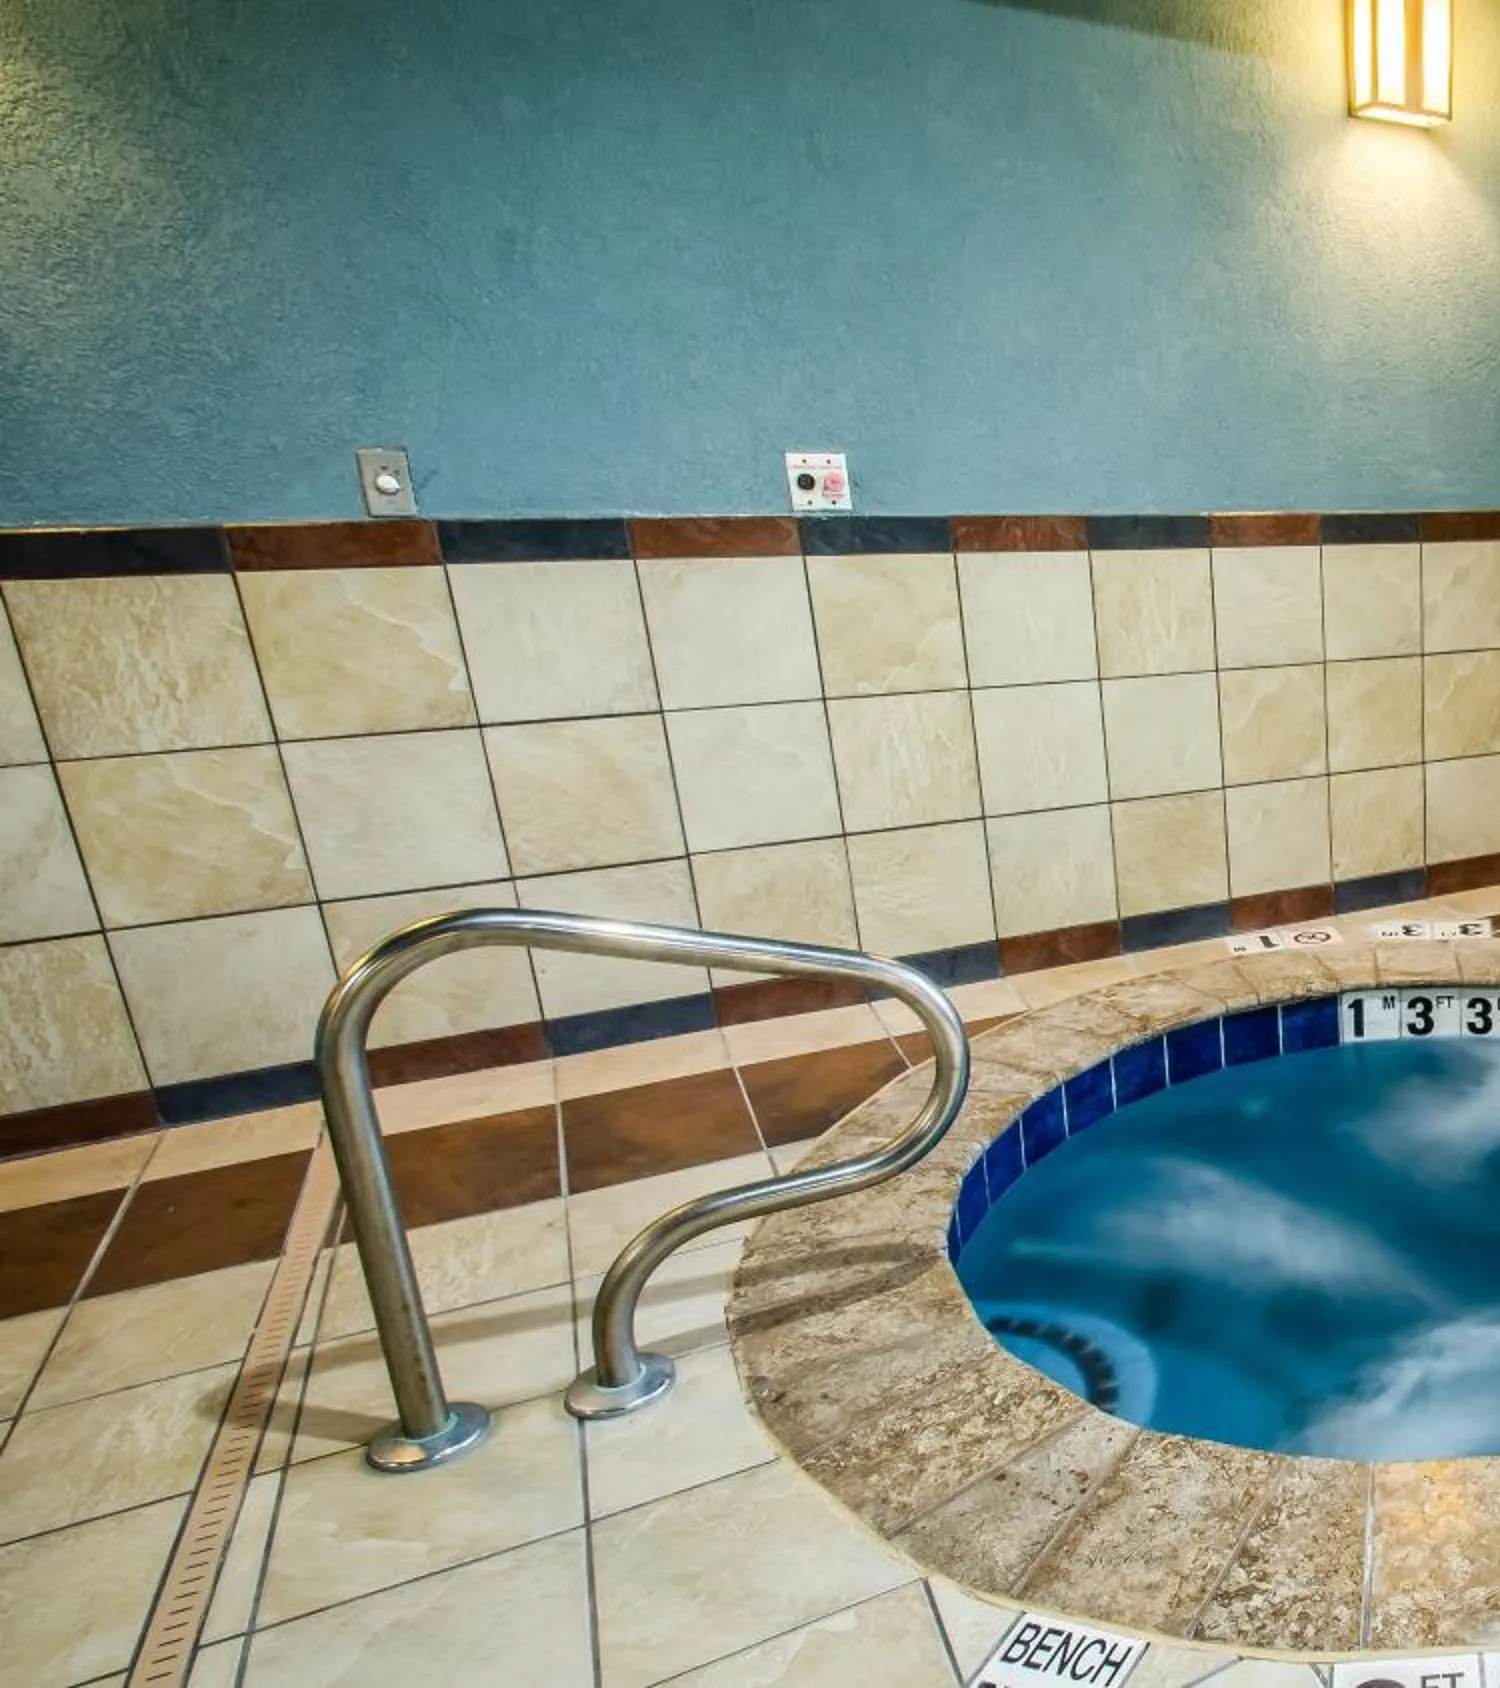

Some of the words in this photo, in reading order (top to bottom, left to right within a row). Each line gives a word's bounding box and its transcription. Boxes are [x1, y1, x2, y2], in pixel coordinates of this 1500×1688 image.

[1347, 998, 1364, 1037] 1
[1383, 995, 1395, 1009] M
[1407, 996, 1434, 1035] 3
[1435, 995, 1454, 1008] FT
[1467, 997, 1493, 1034] 3
[1000, 1622, 1133, 1686] BENCH
